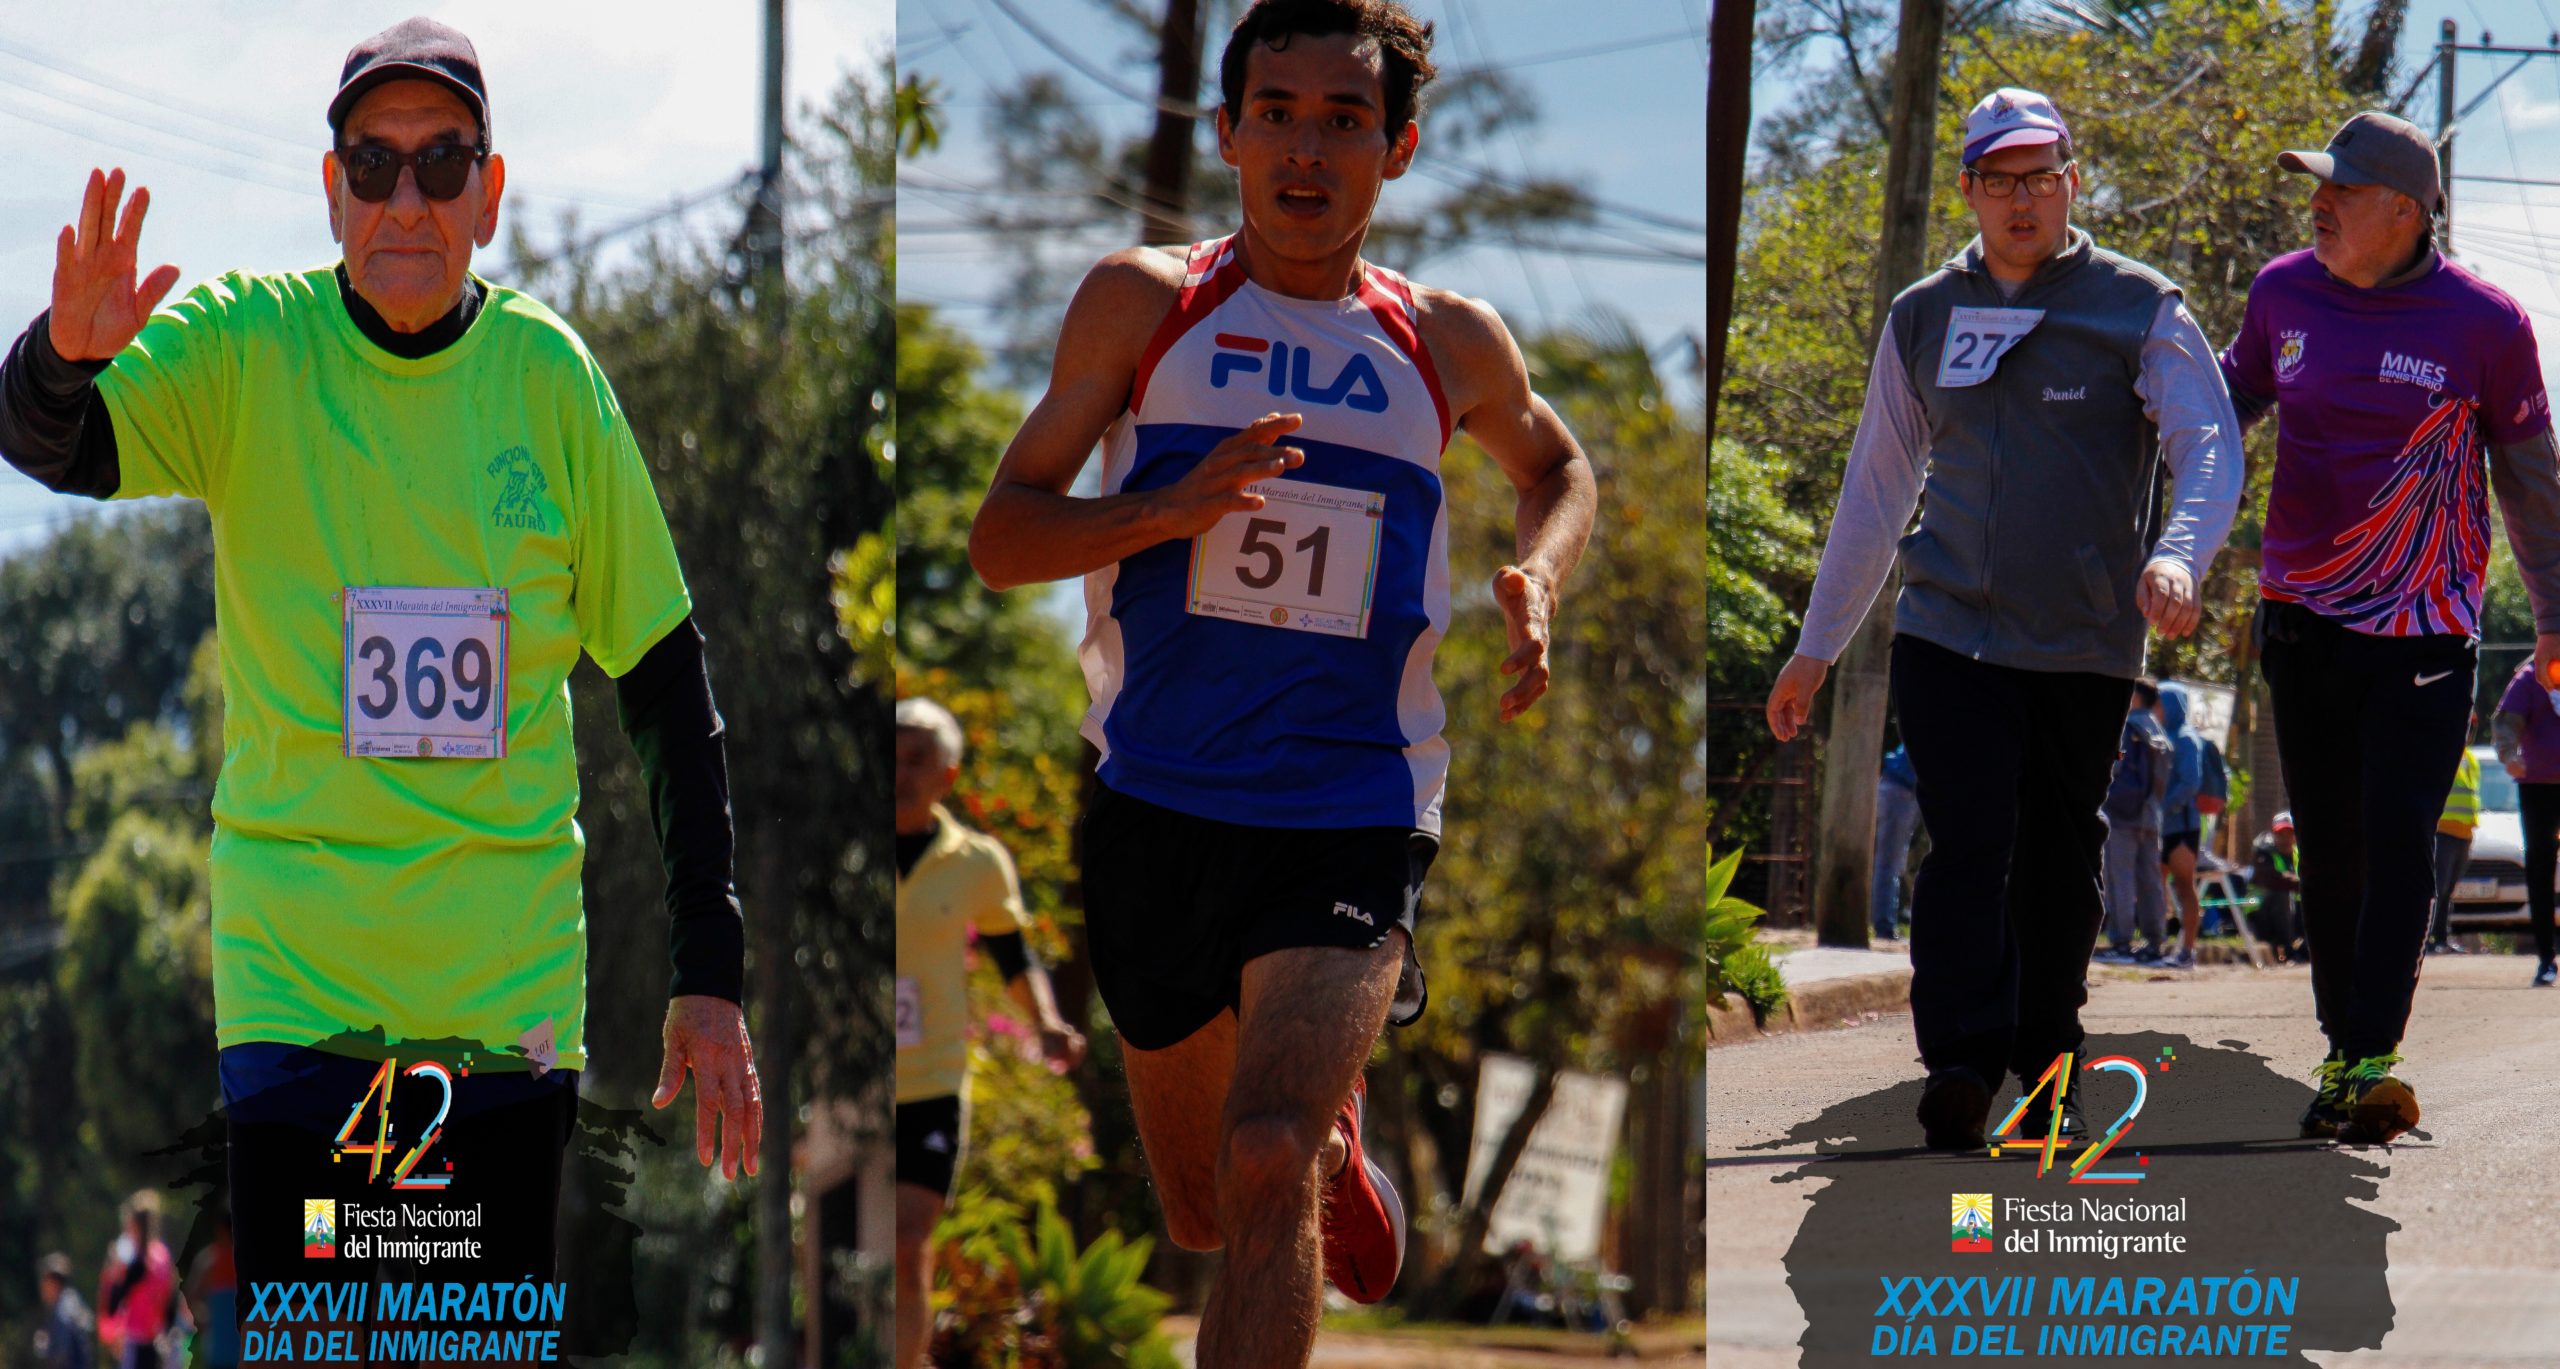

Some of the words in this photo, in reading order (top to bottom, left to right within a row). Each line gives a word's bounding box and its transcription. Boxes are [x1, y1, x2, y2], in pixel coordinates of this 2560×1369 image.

[1210, 333, 1389, 413] FILA
[2381, 351, 2447, 383] MNES
[2380, 368, 2442, 392] MINISTERIO
[2043, 386, 2086, 401] Daniel
[1260, 485, 1299, 500] Maratón
[1301, 491, 1315, 502] del
[1317, 494, 1365, 509] Inmigrante
[494, 513, 546, 532] TAURO
[1235, 517, 1330, 597] 51
[356, 600, 392, 610] XXXVII
[394, 600, 429, 611] Maratón
[431, 600, 443, 612] del
[445, 601, 489, 613] Inmigrante
[357, 636, 492, 722] 369
[1333, 902, 1374, 926] FILA
